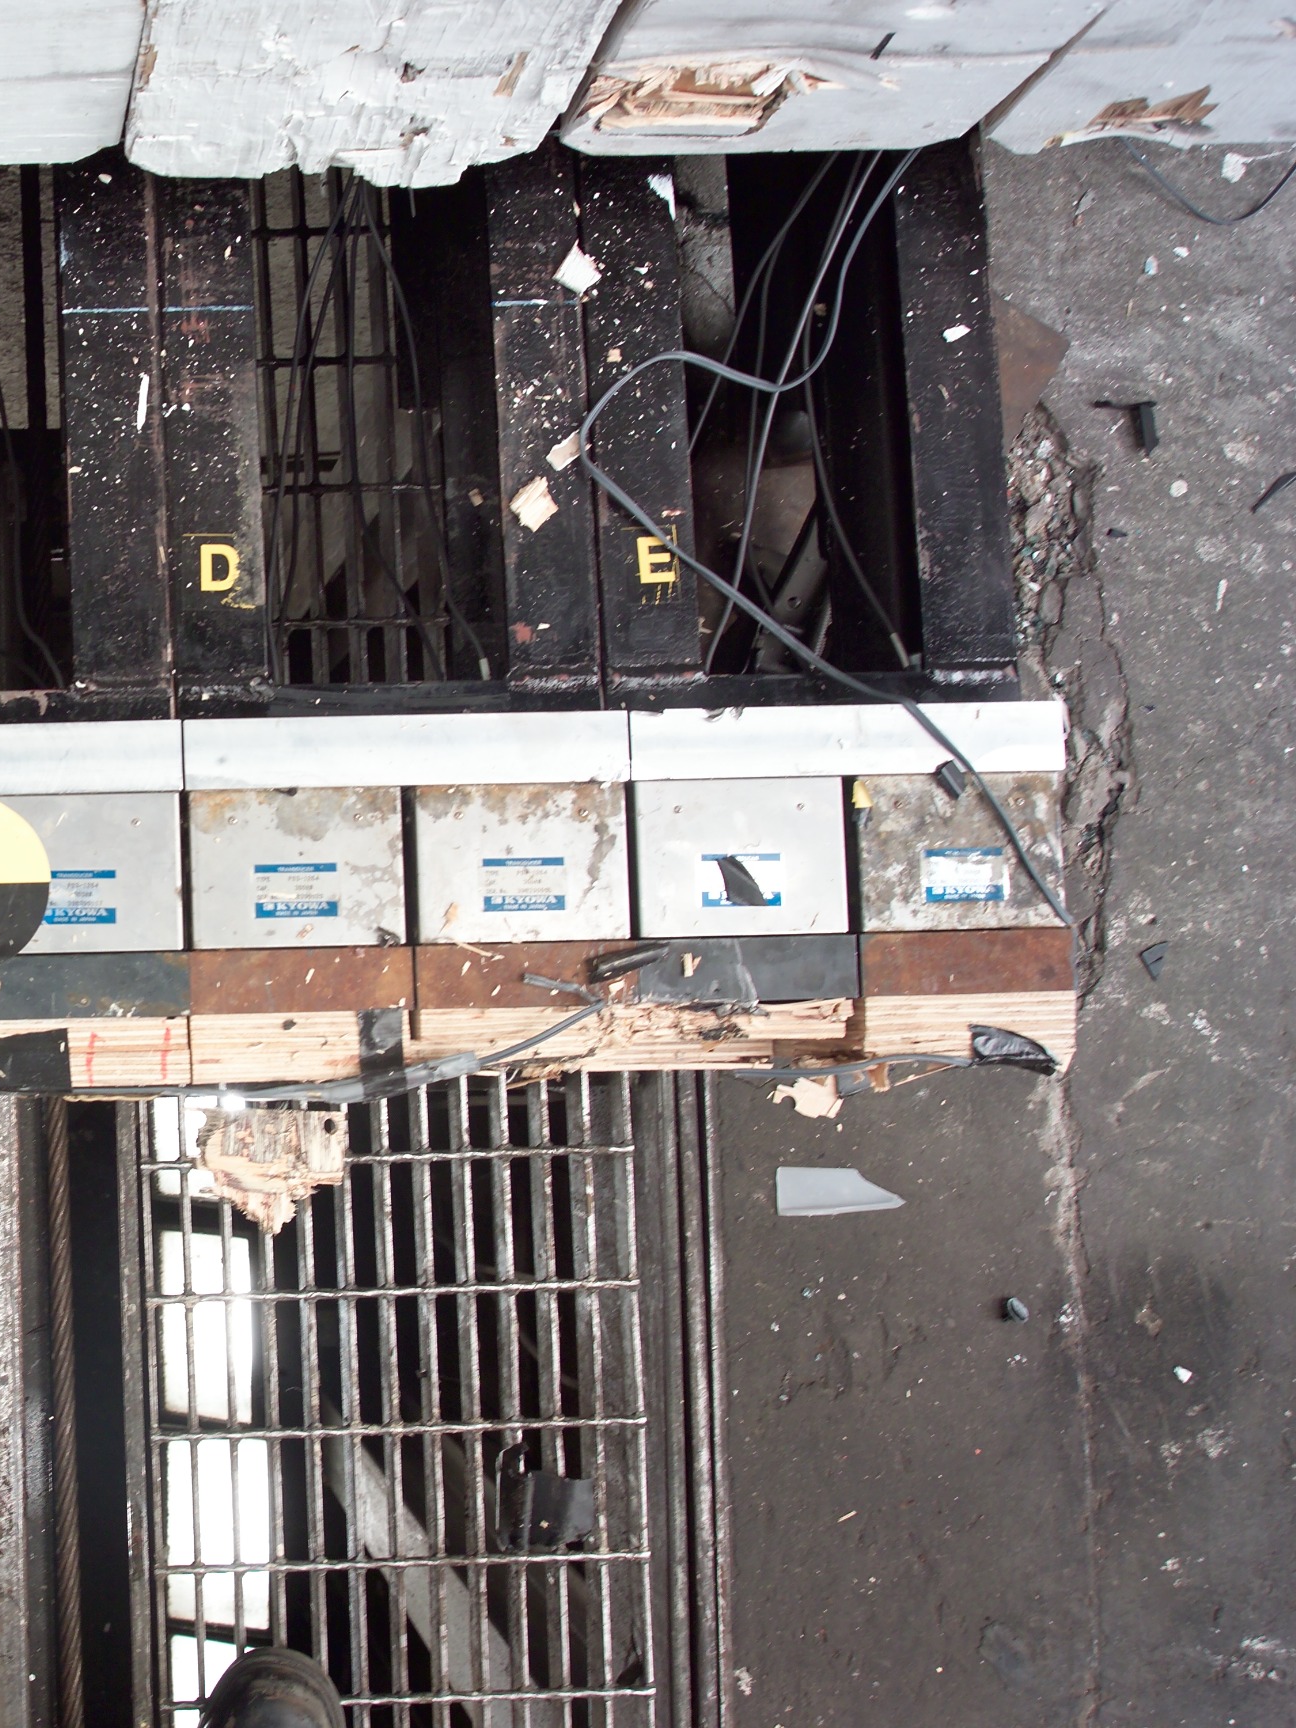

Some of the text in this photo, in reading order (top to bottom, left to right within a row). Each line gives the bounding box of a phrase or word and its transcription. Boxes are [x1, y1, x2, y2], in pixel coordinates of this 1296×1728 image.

[636, 537, 676, 585] E
[200, 543, 240, 592] D
[505, 895, 559, 905] KYOWA
[276, 901, 330, 911] KYOWA
[55, 908, 109, 917] KYOWA
